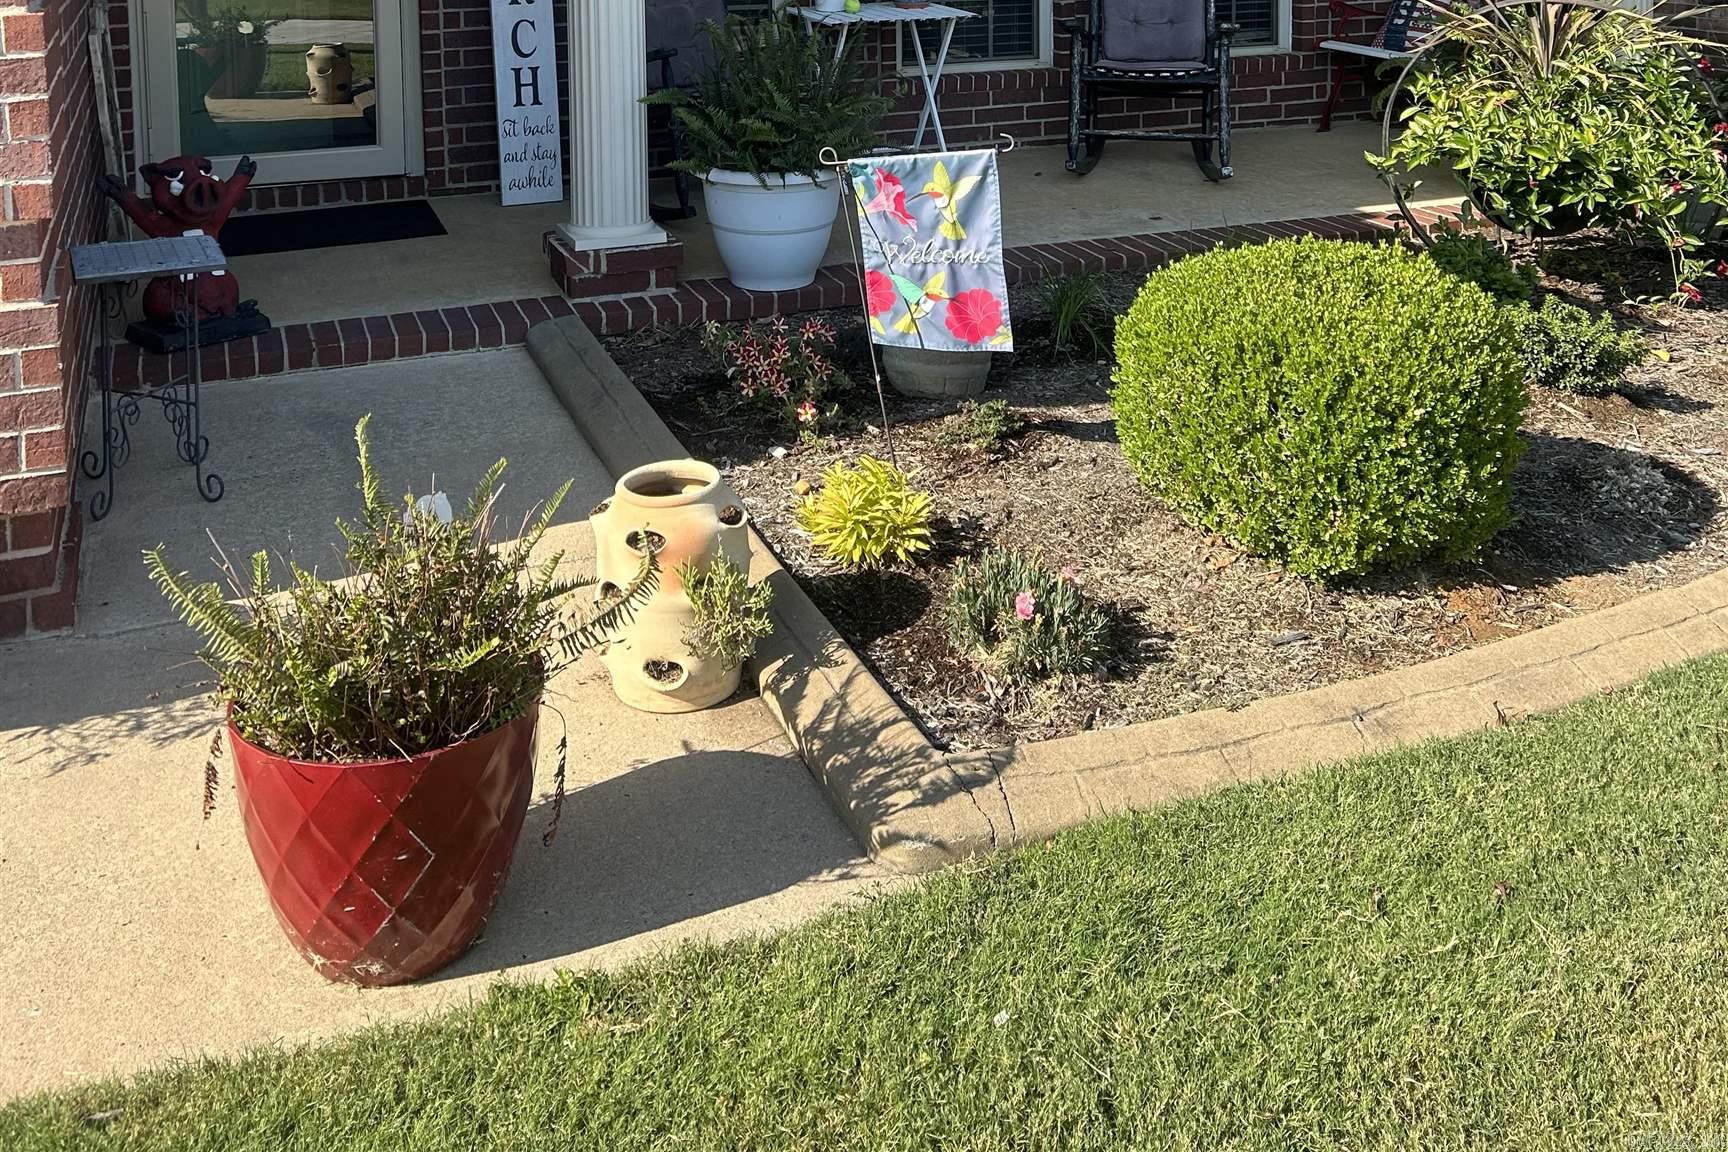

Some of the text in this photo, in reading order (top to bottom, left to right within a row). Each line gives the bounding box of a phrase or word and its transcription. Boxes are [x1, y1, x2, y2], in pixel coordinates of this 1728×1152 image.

[523, 115, 555, 136] back
[504, 142, 557, 169] and stay
[508, 165, 554, 190] awhile
[882, 235, 990, 265] Welcome
